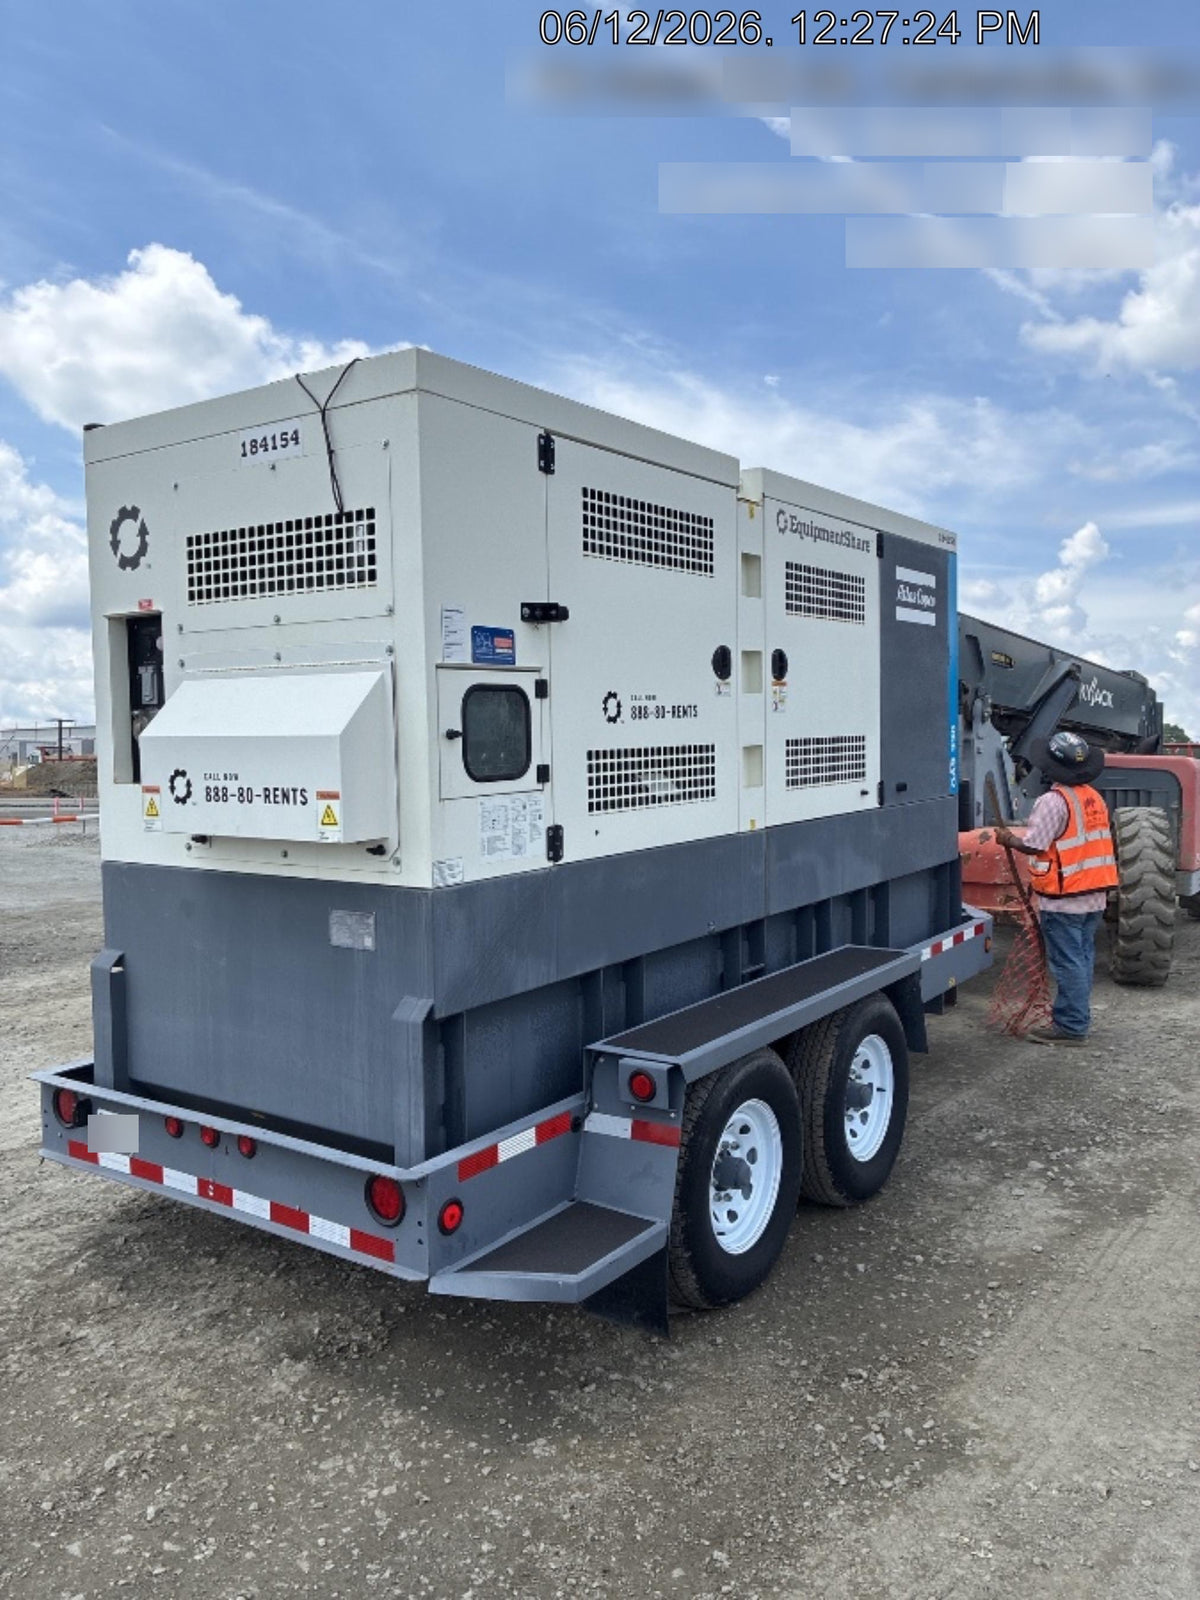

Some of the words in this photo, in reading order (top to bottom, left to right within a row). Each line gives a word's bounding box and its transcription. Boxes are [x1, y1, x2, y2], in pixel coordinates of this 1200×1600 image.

[241, 429, 300, 457] 184154
[789, 514, 870, 553] EquipmentShare
[205, 785, 308, 806] 888-80-RENTS
